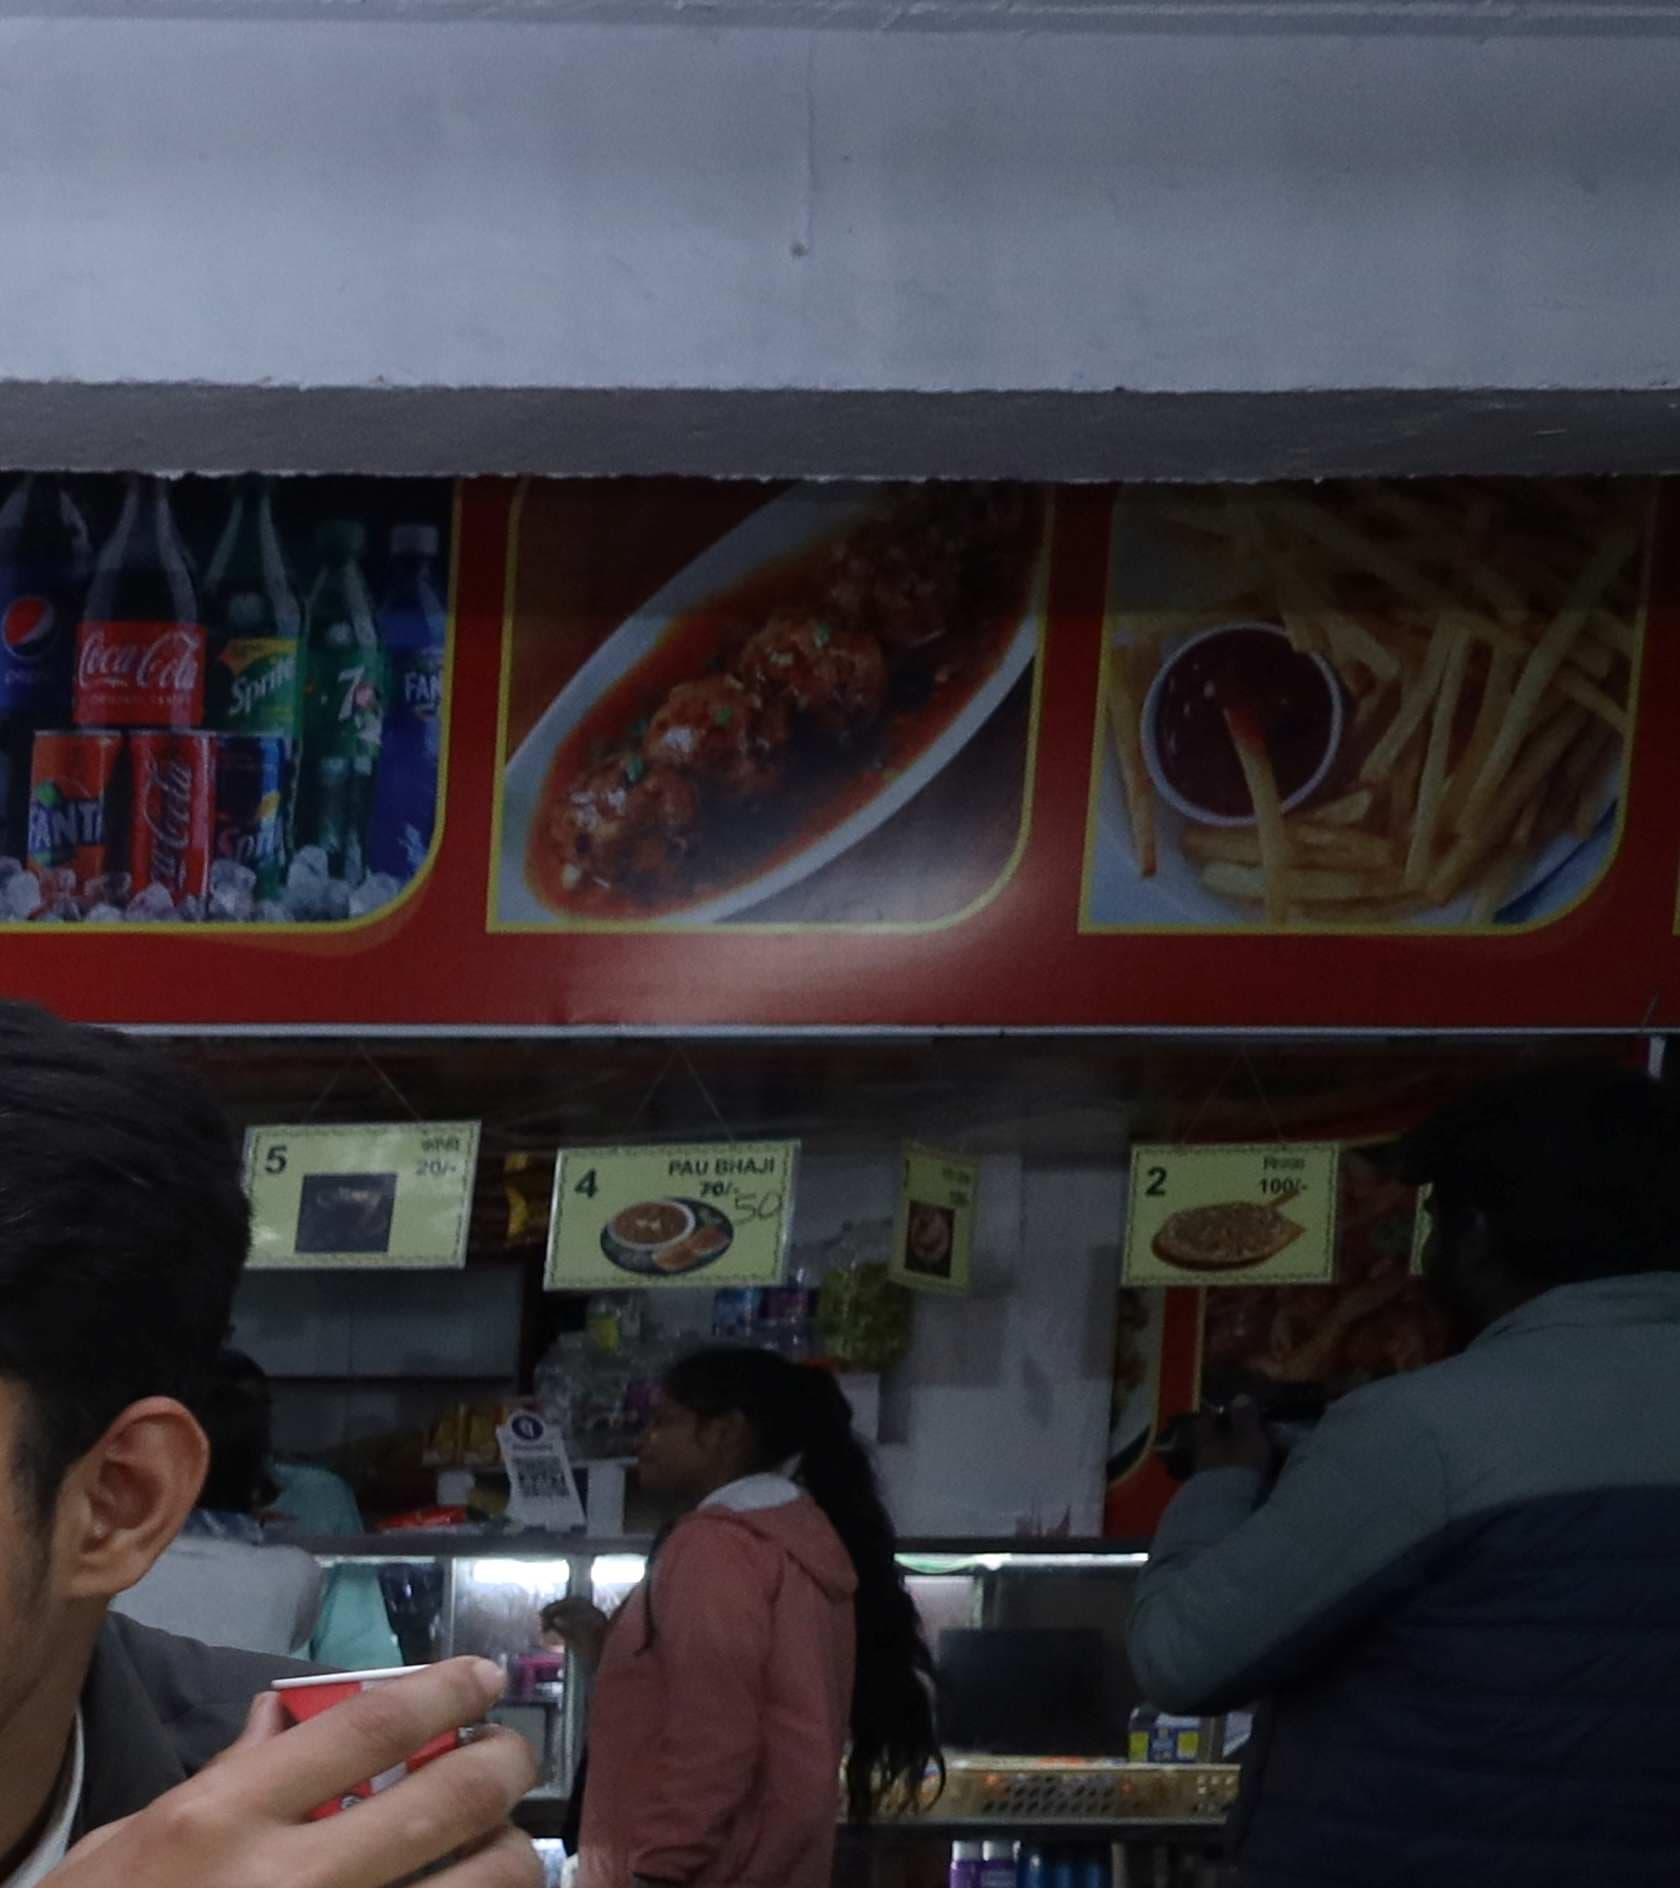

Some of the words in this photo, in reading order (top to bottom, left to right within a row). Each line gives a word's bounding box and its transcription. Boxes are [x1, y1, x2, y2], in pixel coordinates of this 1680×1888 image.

[265, 1145, 287, 1174] 5
[668, 1160, 708, 1176] PAU
[715, 1158, 775, 1174] BHAJI
[575, 1169, 597, 1197] 4
[1146, 1167, 1166, 1195] 2
